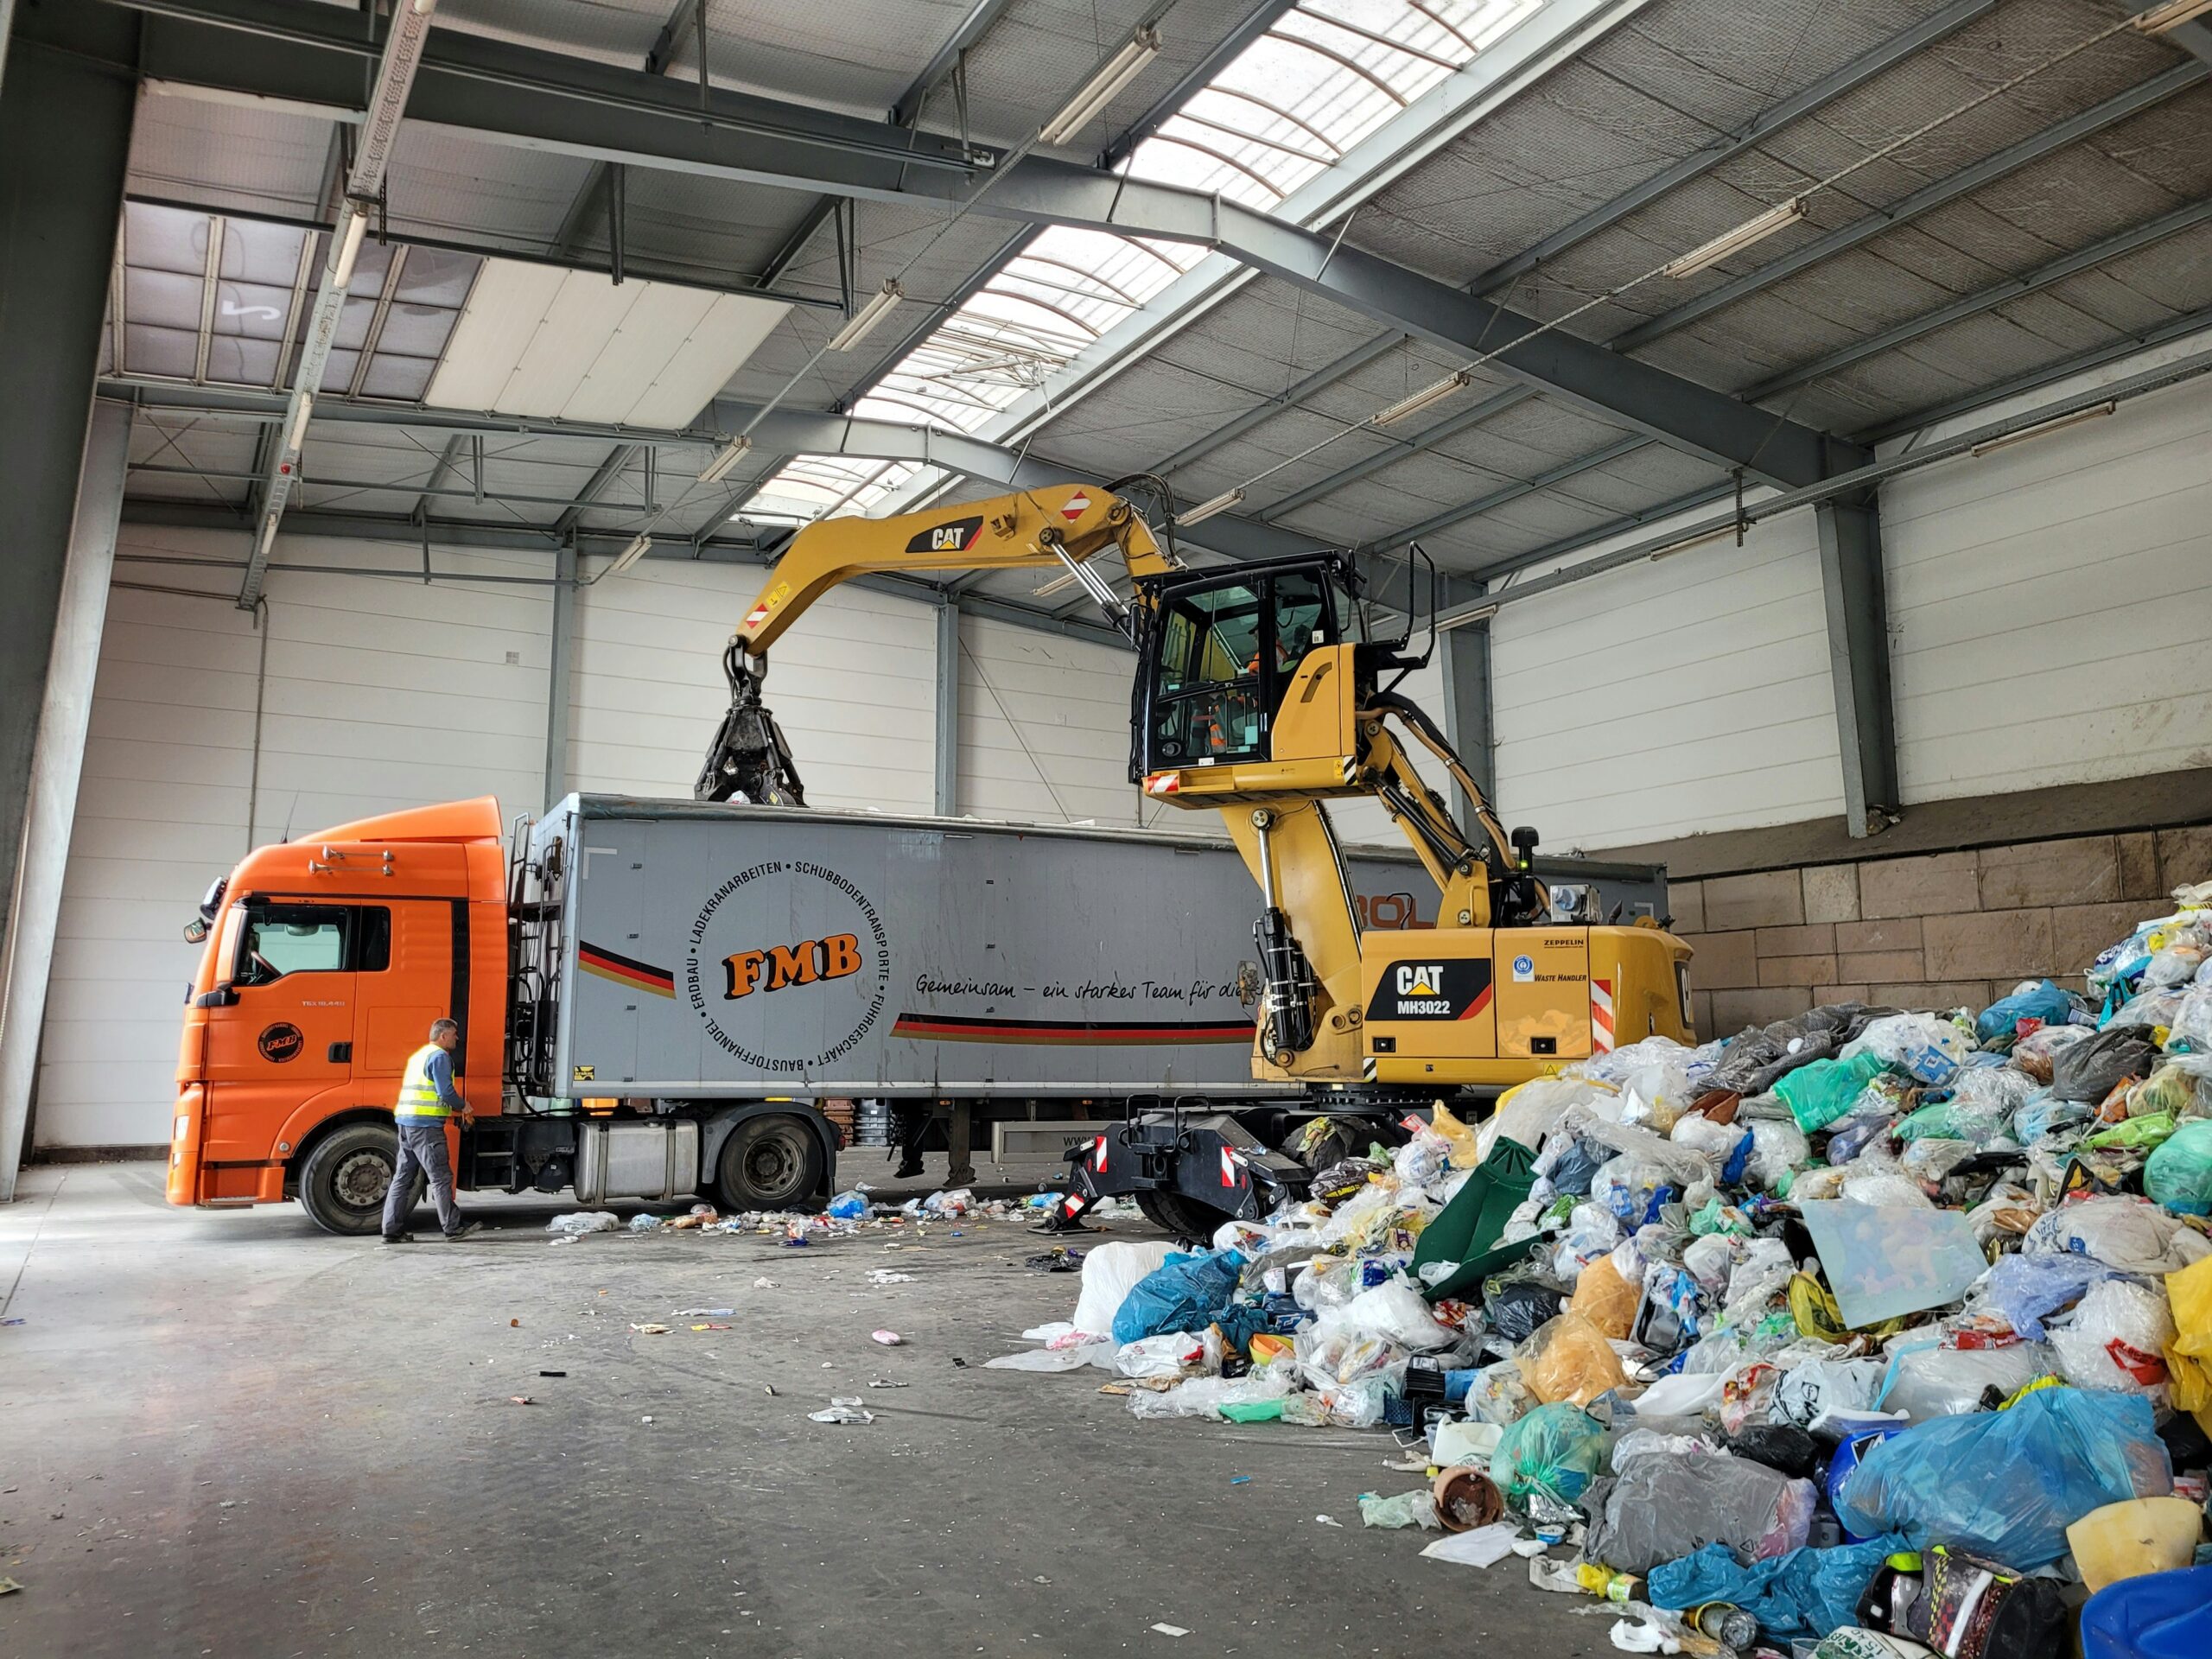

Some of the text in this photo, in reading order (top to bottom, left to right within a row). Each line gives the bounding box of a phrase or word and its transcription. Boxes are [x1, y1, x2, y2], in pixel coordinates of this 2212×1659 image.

[931, 527, 964, 550] CAT
[690, 861, 782, 944] LADEKRANARBEITEN
[795, 861, 891, 982] SCHUBBODENTRANSPORTE
[686, 957, 706, 1010] ERDBAU
[721, 933, 862, 1001] FMB
[916, 974, 1016, 998] Gemeinsam
[1042, 982, 1070, 998] ein
[1074, 980, 1136, 1000] starkes
[1141, 982, 1185, 1000] Team
[1188, 980, 1215, 1007] für
[1396, 965, 1444, 995] CAT
[817, 993, 885, 1067] FUHRGESCHÄFT
[1397, 1000, 1451, 1015] MH3022
[266, 1034, 297, 1052] FMB
[705, 1017, 804, 1071] BAUSTOFFHANDEL
